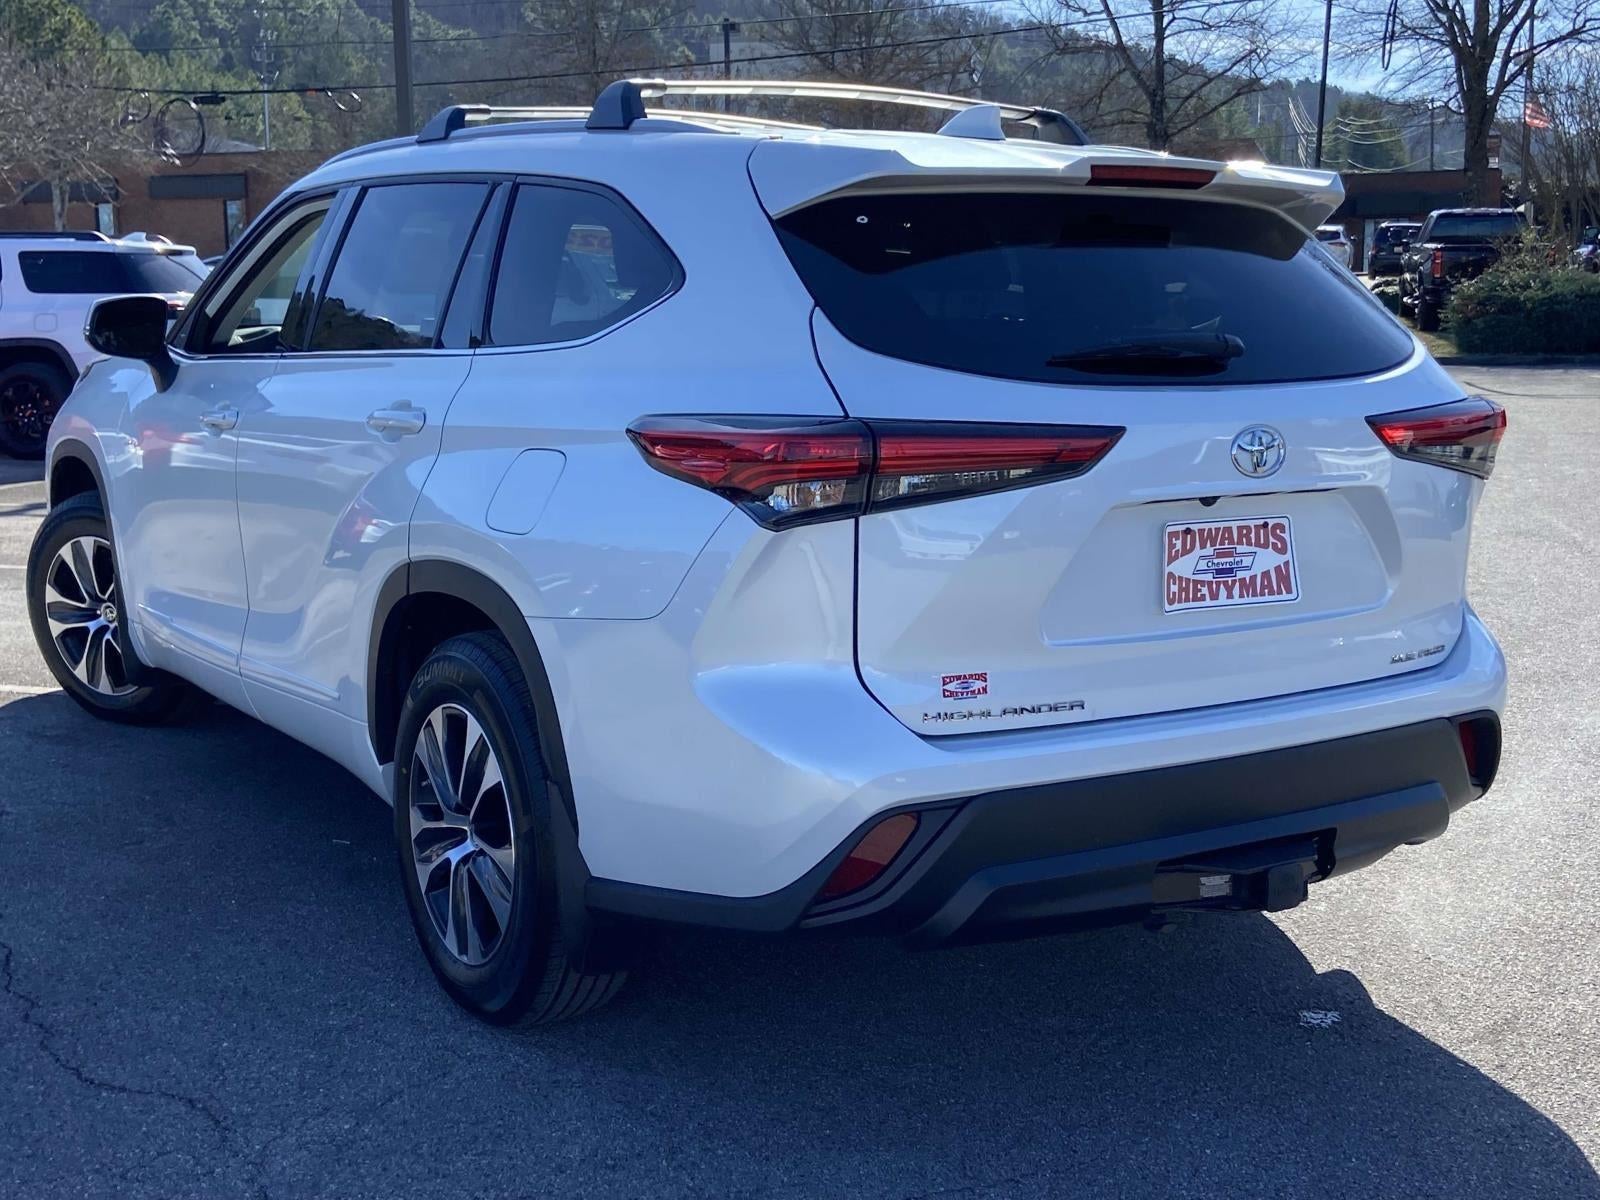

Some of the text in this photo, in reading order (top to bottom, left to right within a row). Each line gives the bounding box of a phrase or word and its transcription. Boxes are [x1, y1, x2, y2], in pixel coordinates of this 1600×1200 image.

[1166, 523, 1288, 567] EDWARDS
[1206, 558, 1243, 568] Chevrolet
[1166, 560, 1292, 606] CHEVYMAN
[941, 672, 988, 687] EDWARDS
[942, 684, 988, 698] CHEVYMAN
[922, 699, 1085, 724] HIGHLANDER
